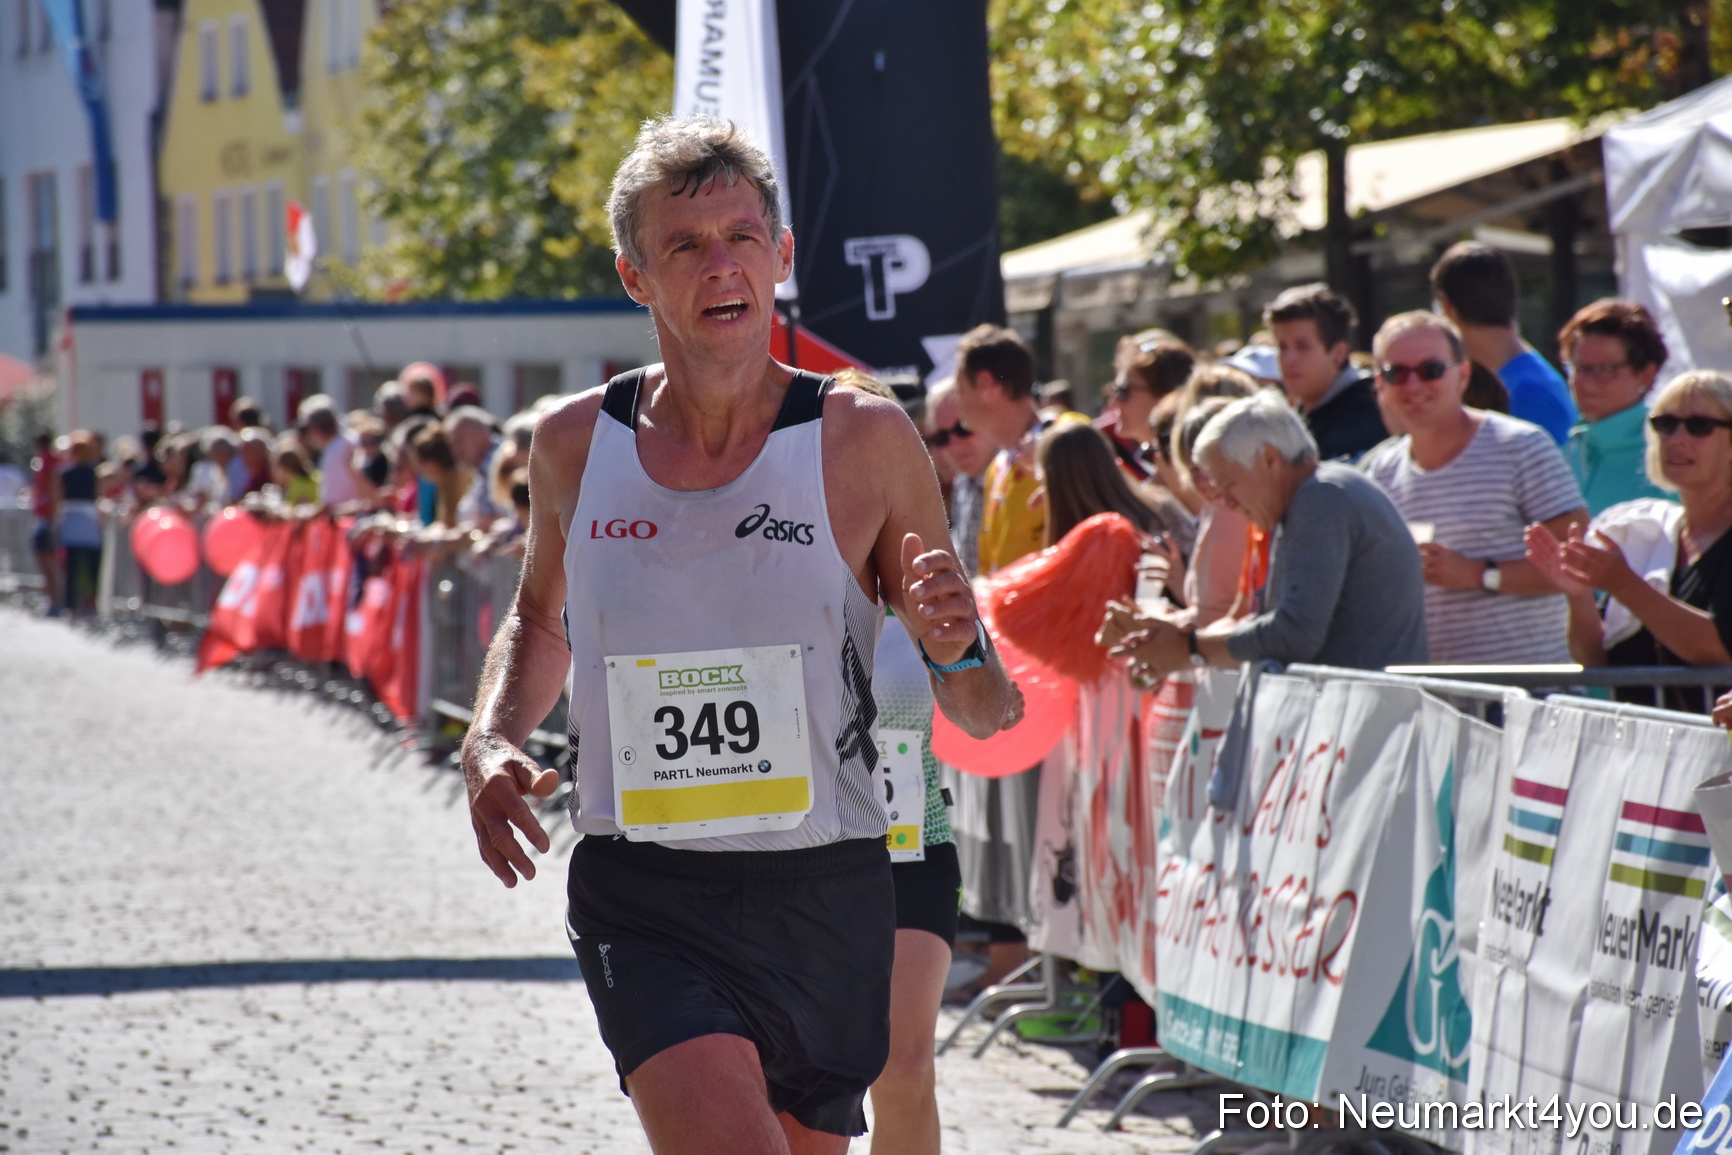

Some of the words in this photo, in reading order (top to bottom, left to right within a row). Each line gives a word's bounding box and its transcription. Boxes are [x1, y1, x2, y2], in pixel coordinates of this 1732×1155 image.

[590, 519, 658, 540] LGO
[658, 664, 746, 690] BOCK
[659, 688, 686, 697] inspired
[687, 688, 696, 696] by
[697, 686, 716, 695] smart
[717, 684, 748, 694] concepts
[654, 700, 760, 761] 349
[654, 769, 693, 781] PARTL
[696, 763, 754, 778] Neumarkt
